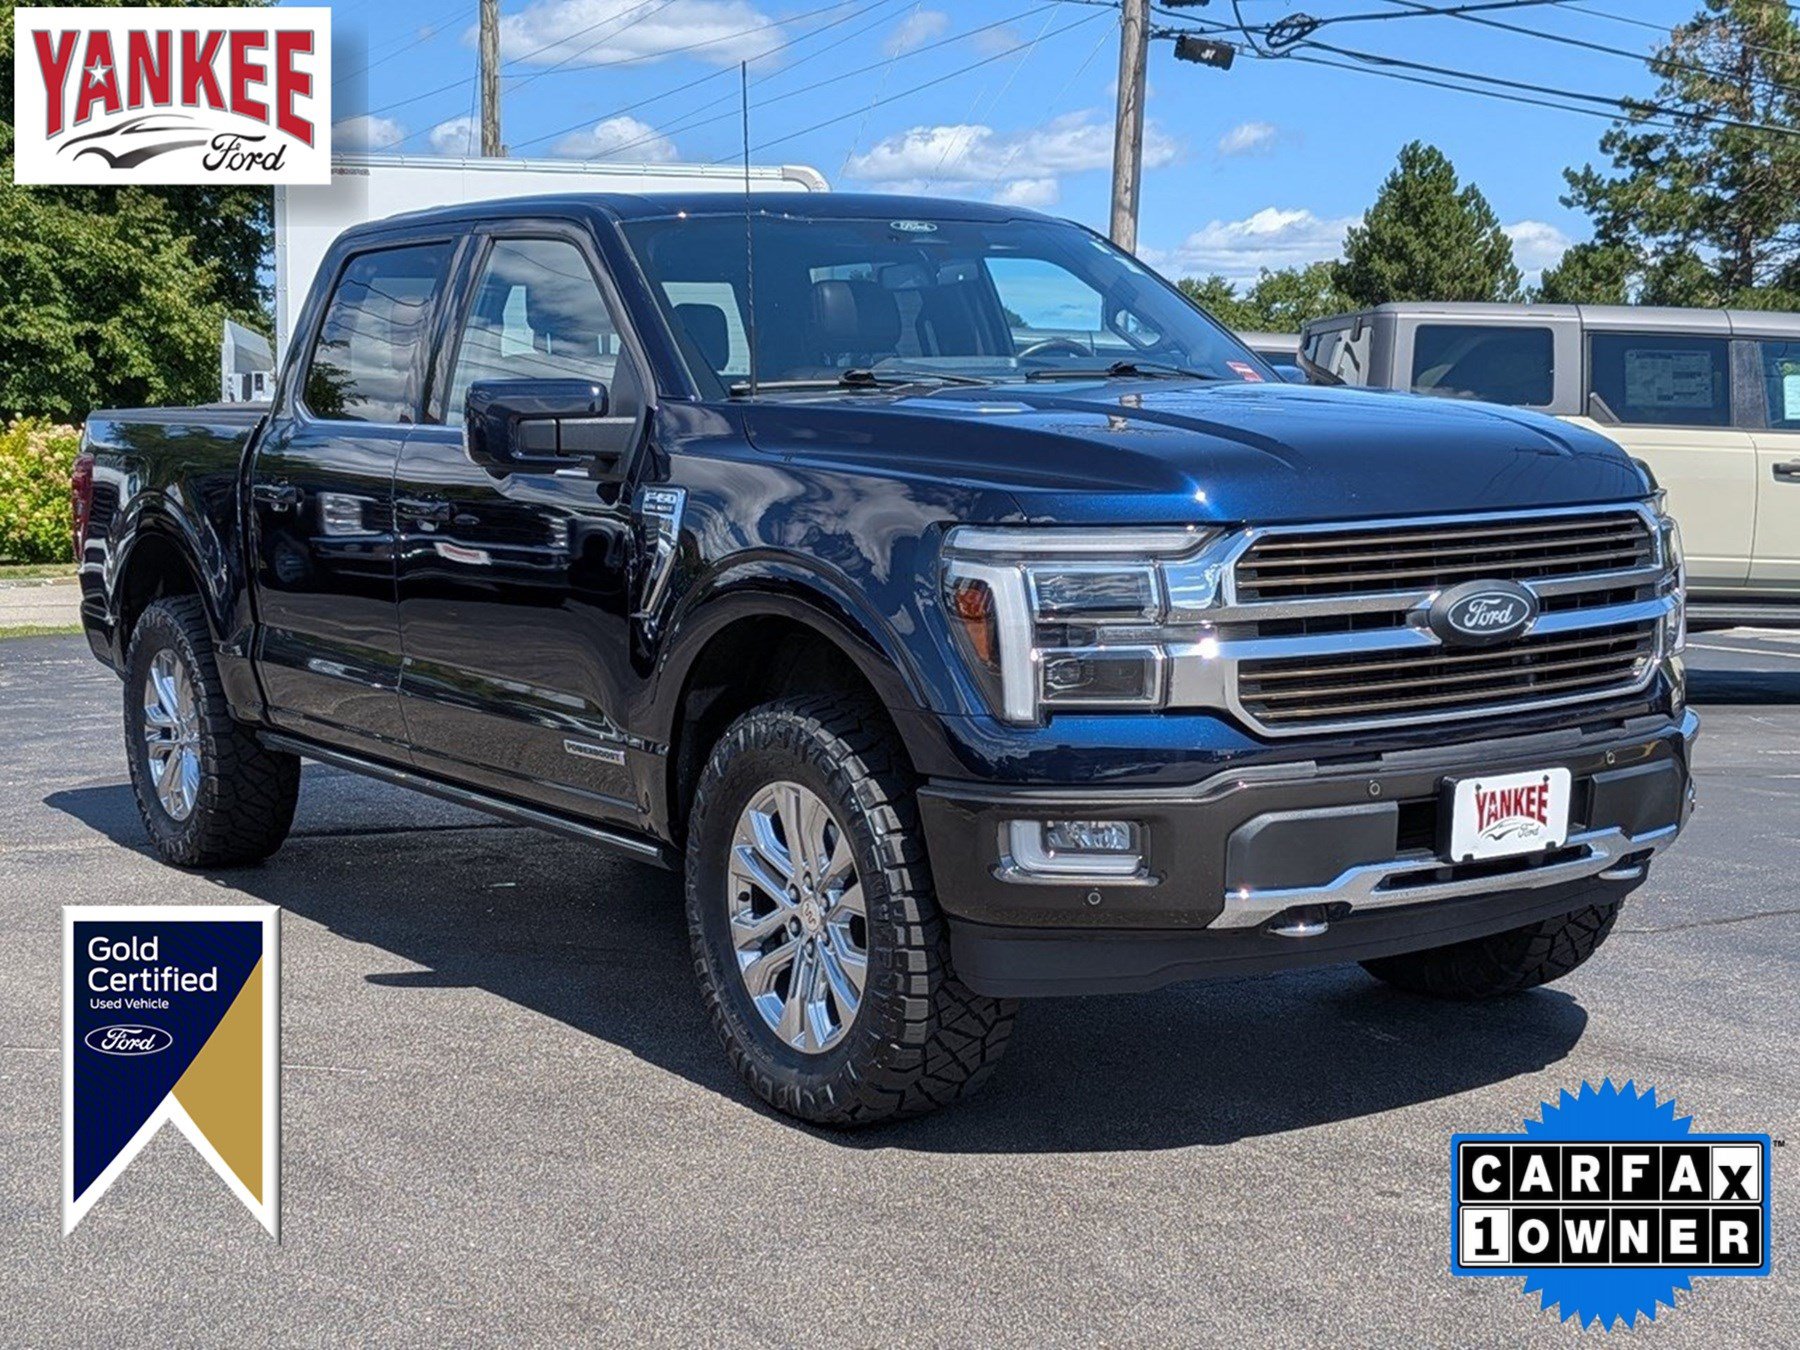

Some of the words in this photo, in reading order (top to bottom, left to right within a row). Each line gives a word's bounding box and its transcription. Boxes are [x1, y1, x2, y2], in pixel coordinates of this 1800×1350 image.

[1463, 598, 1514, 628] Ford
[1475, 783, 1550, 835] YANKEE
[1517, 821, 1541, 839] Ford
